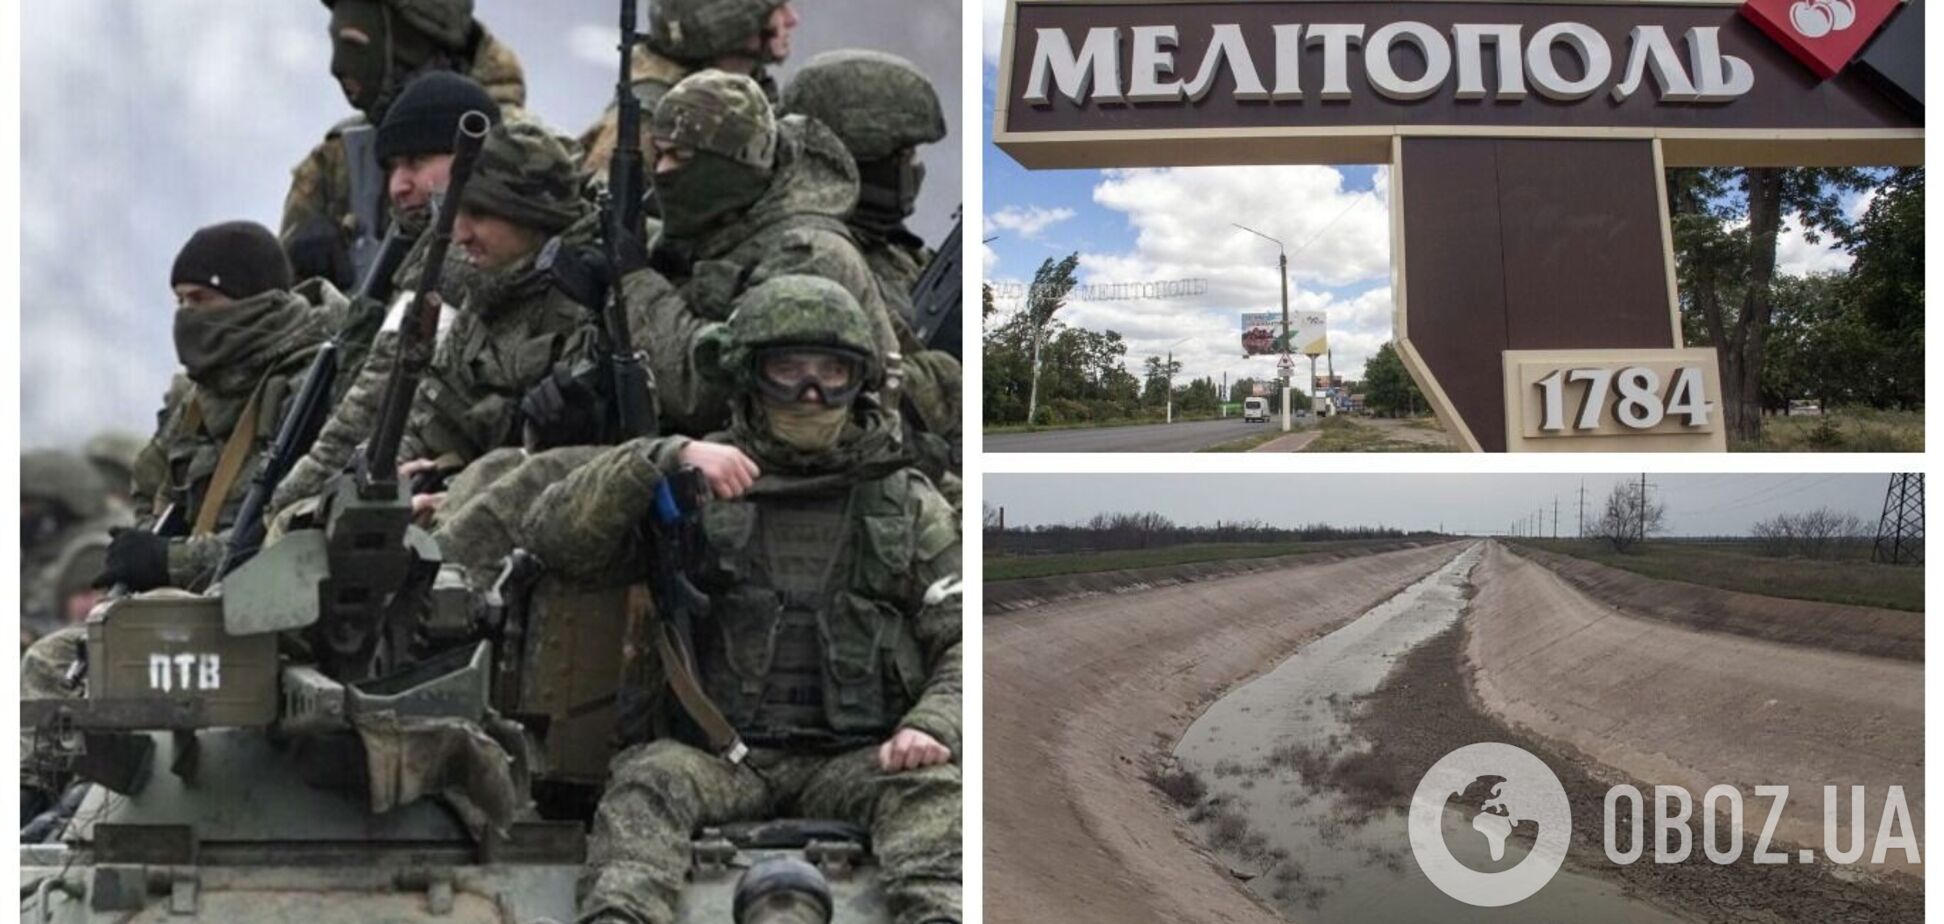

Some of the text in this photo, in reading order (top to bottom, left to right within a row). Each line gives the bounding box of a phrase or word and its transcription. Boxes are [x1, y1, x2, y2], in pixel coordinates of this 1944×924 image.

[1022, 21, 1755, 106] МЕЛІТОПОЛЬ
[1533, 366, 1714, 431] 1784
[149, 653, 220, 693] ПТВ
